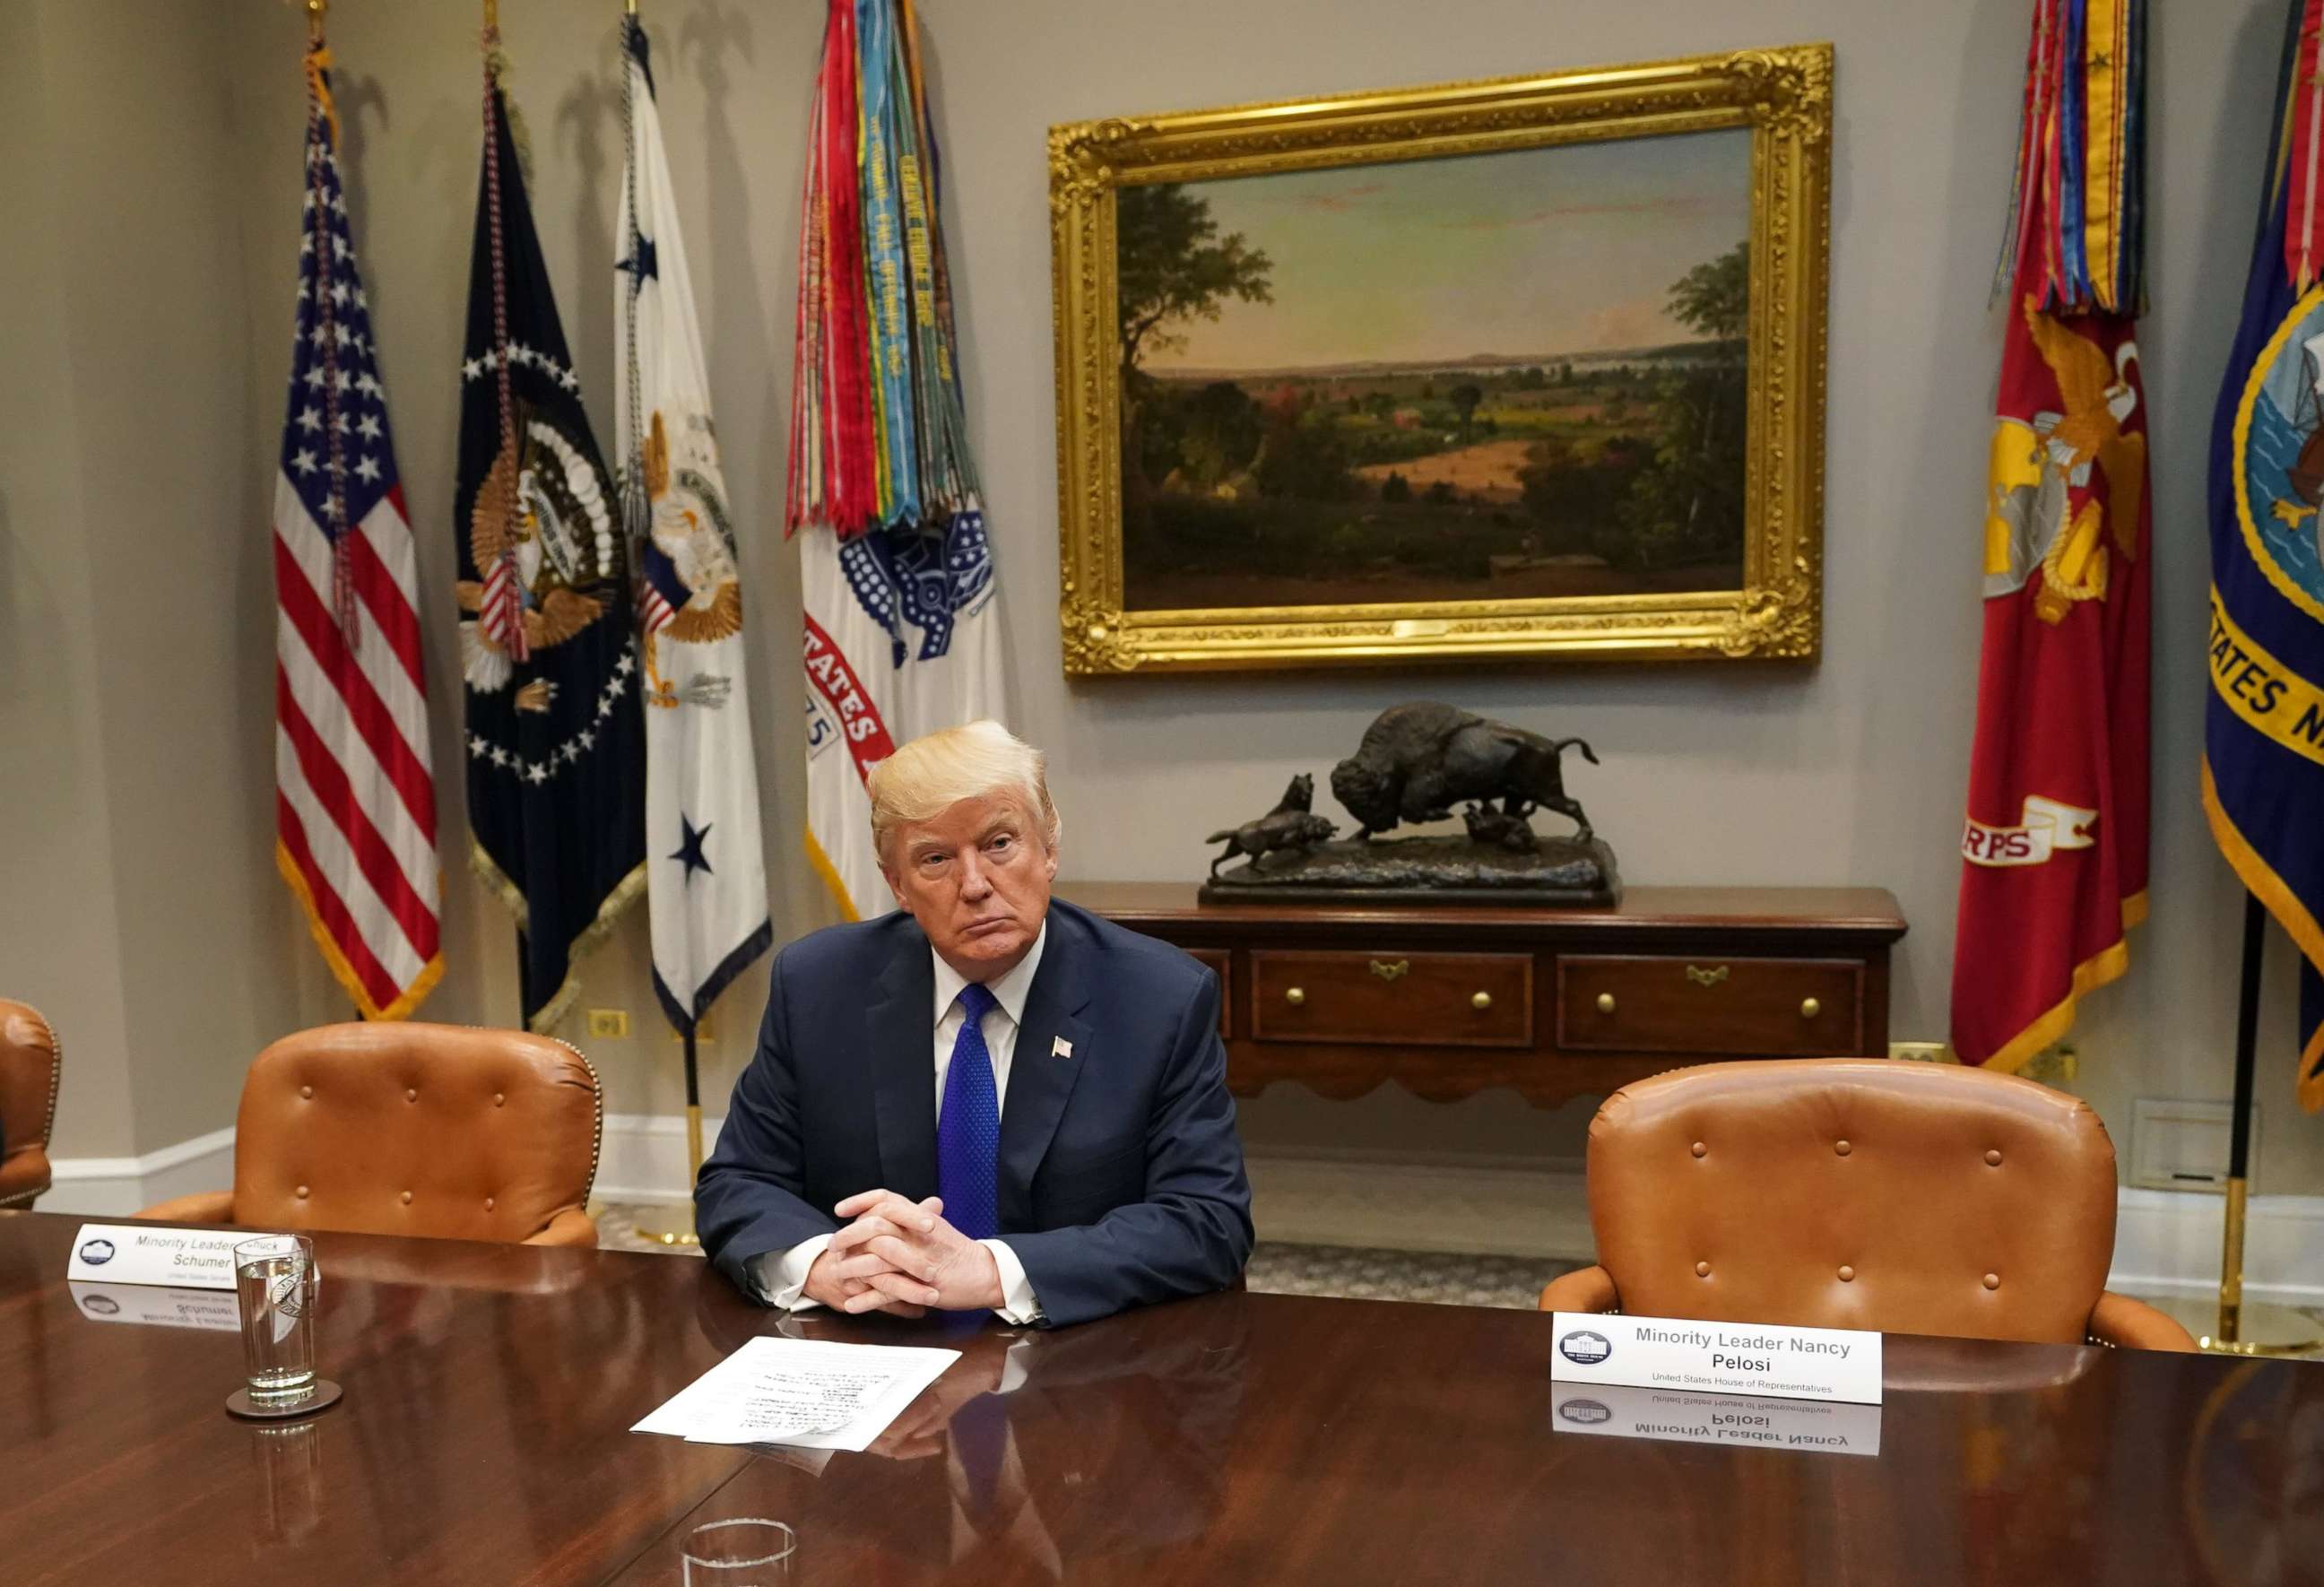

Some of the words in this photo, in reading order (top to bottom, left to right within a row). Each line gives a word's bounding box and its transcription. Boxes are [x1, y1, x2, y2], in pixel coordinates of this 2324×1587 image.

[135, 1235, 186, 1249] Minority
[191, 1239, 235, 1251] Leader
[173, 1253, 230, 1268] Schumer
[1636, 1327, 1712, 1349] Minority
[1719, 1333, 1783, 1350] Leader
[1790, 1338, 1851, 1359] Nancy
[1713, 1354, 1771, 1372] Pelosi
[1652, 1373, 1681, 1383] United
[1684, 1375, 1712, 1385] States
[1714, 1376, 1744, 1387] House
[1746, 1379, 1756, 1388] of
[1757, 1380, 1833, 1393] Representatives
